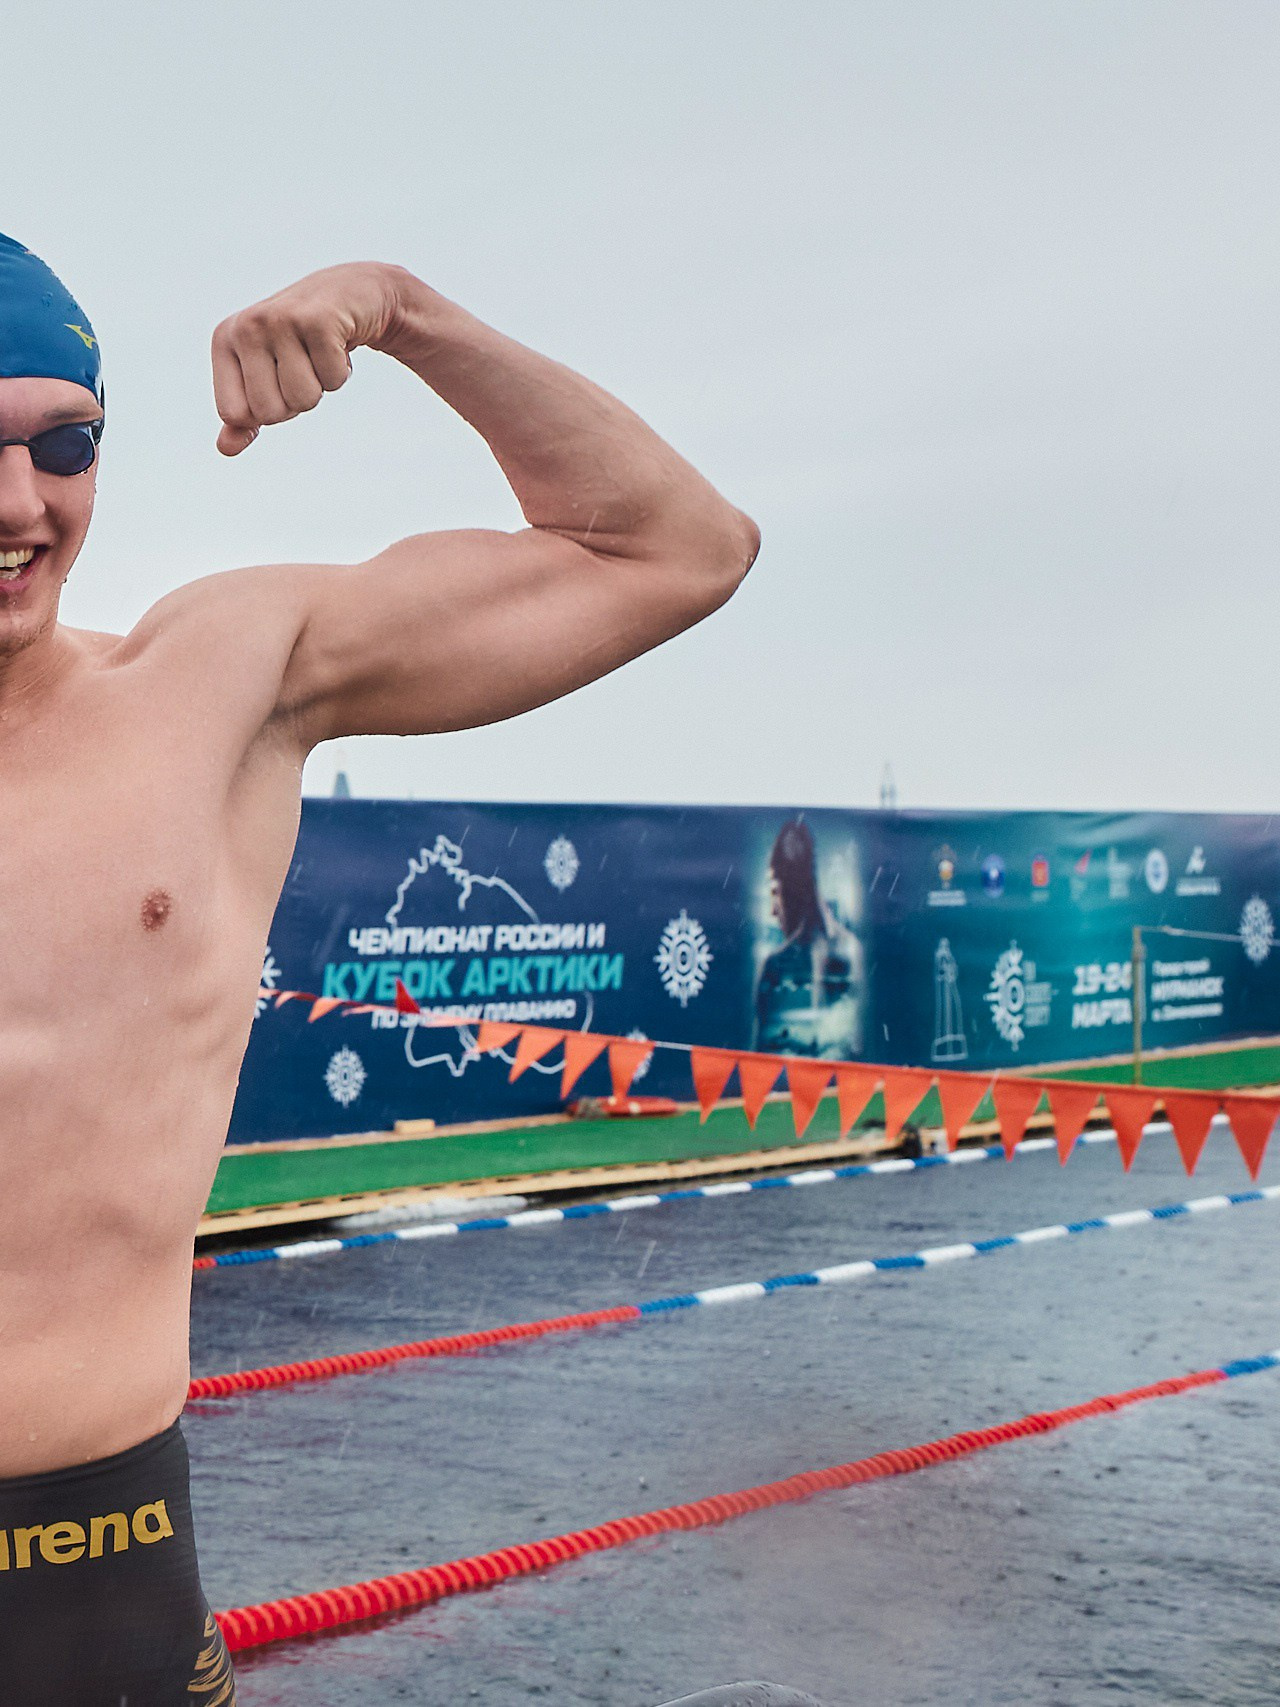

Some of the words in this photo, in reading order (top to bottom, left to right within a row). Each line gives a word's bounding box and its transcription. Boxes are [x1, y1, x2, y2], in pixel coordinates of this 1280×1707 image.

[348, 925, 493, 955] ЧЕМПИОНАТ
[494, 923, 586, 951] РОССИИ
[587, 923, 606, 948] И
[322, 958, 456, 1001] КУБОК
[460, 952, 624, 997] АРКТИКИ
